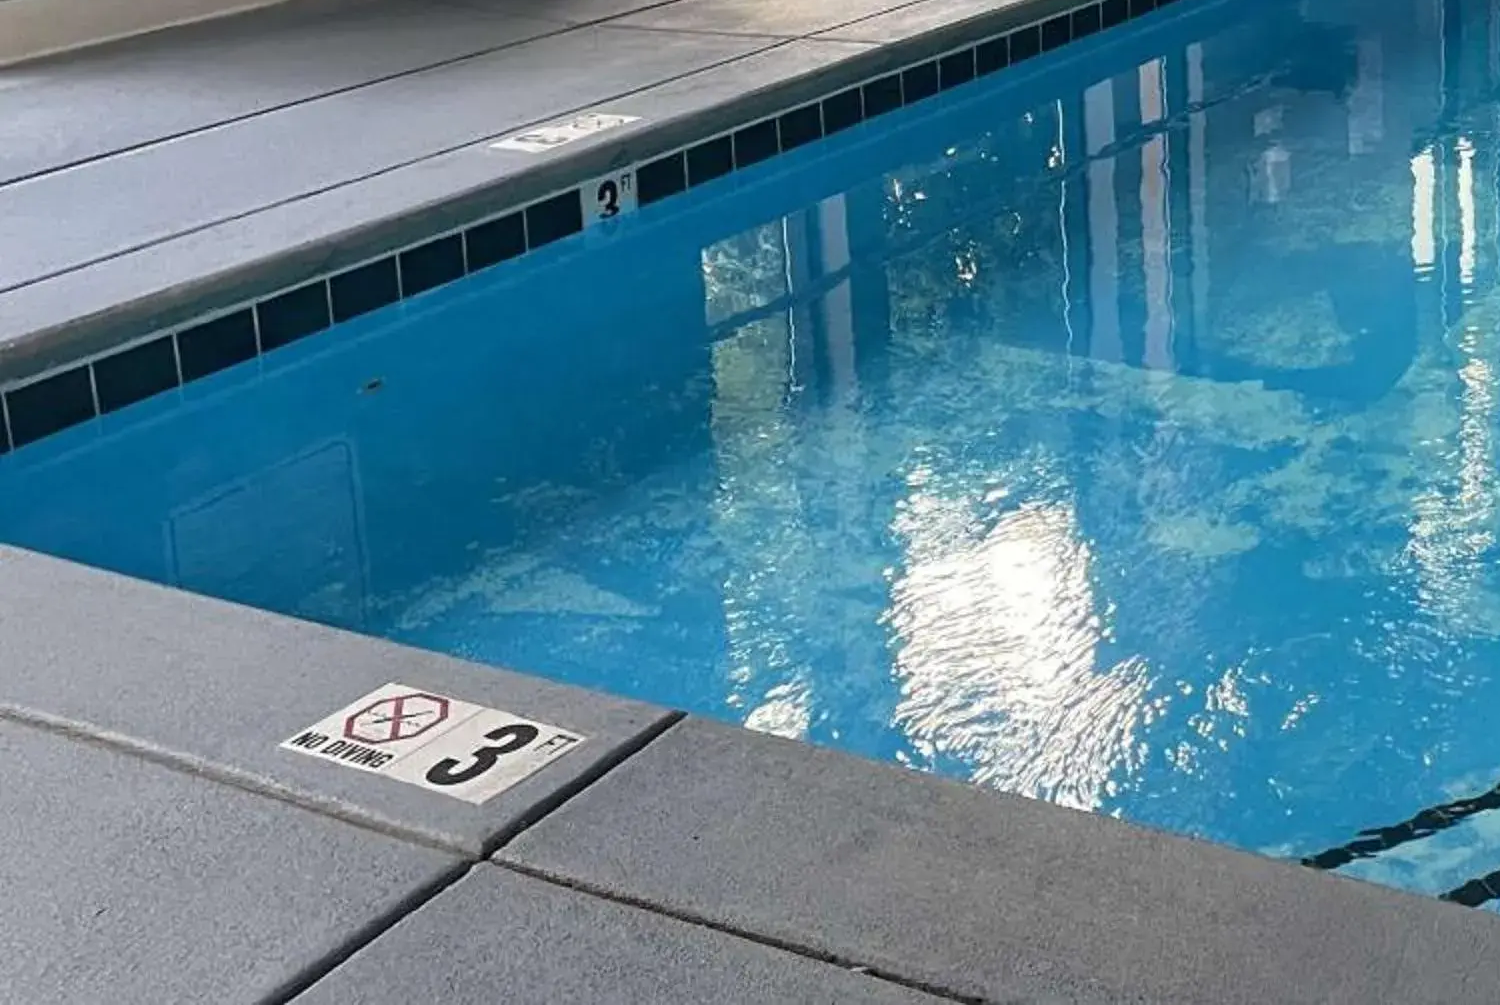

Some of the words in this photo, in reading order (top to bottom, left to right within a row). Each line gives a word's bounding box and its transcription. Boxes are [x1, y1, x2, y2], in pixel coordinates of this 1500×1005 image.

[291, 731, 322, 750] NO
[321, 739, 395, 769] DIVING
[426, 724, 539, 786] 3
